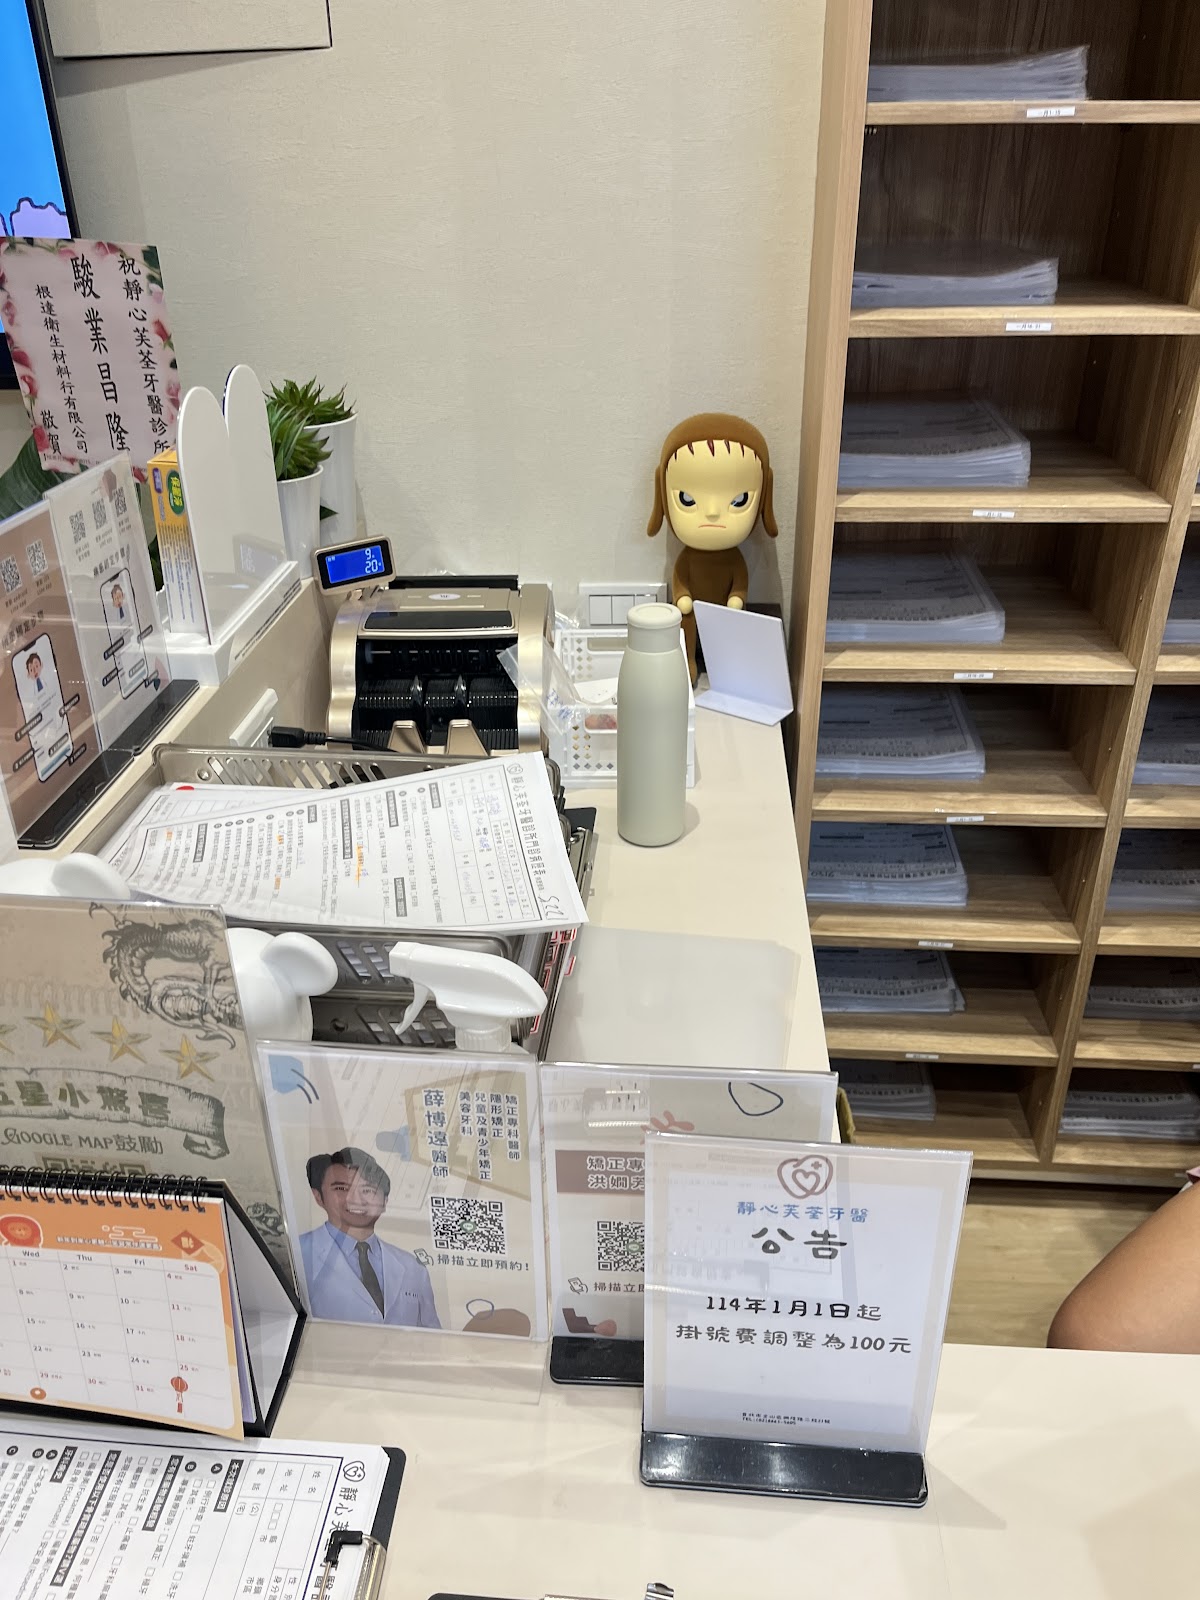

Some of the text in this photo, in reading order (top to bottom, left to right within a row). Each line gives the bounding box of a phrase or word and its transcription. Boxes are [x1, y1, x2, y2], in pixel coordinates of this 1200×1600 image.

[40, 410, 62, 455] 敬賀
[364, 548, 372, 561] 9
[364, 559, 379, 574] 20
[459, 1091, 473, 1136] 美容牙科
[490, 1093, 504, 1138] 隱形矯正
[505, 1094, 520, 1161] 矯正專科醫師
[1, 1127, 73, 1148] GOOGLE
[423, 1089, 449, 1178] 薛博遠醫師
[475, 1092, 492, 1181] 兒童及青少年矯正
[587, 1156, 645, 1172] 矯正專
[737, 1201, 870, 1224] 靜心芙荃牙醫
[752, 1226, 848, 1261] 公告
[22, 1250, 198, 1272] Wed Thu Fri Sat
[706, 1296, 882, 1322] 114年1月1日起
[676, 1324, 912, 1355] 掛號費調整為100元
[307, 1470, 322, 1494] 姓名
